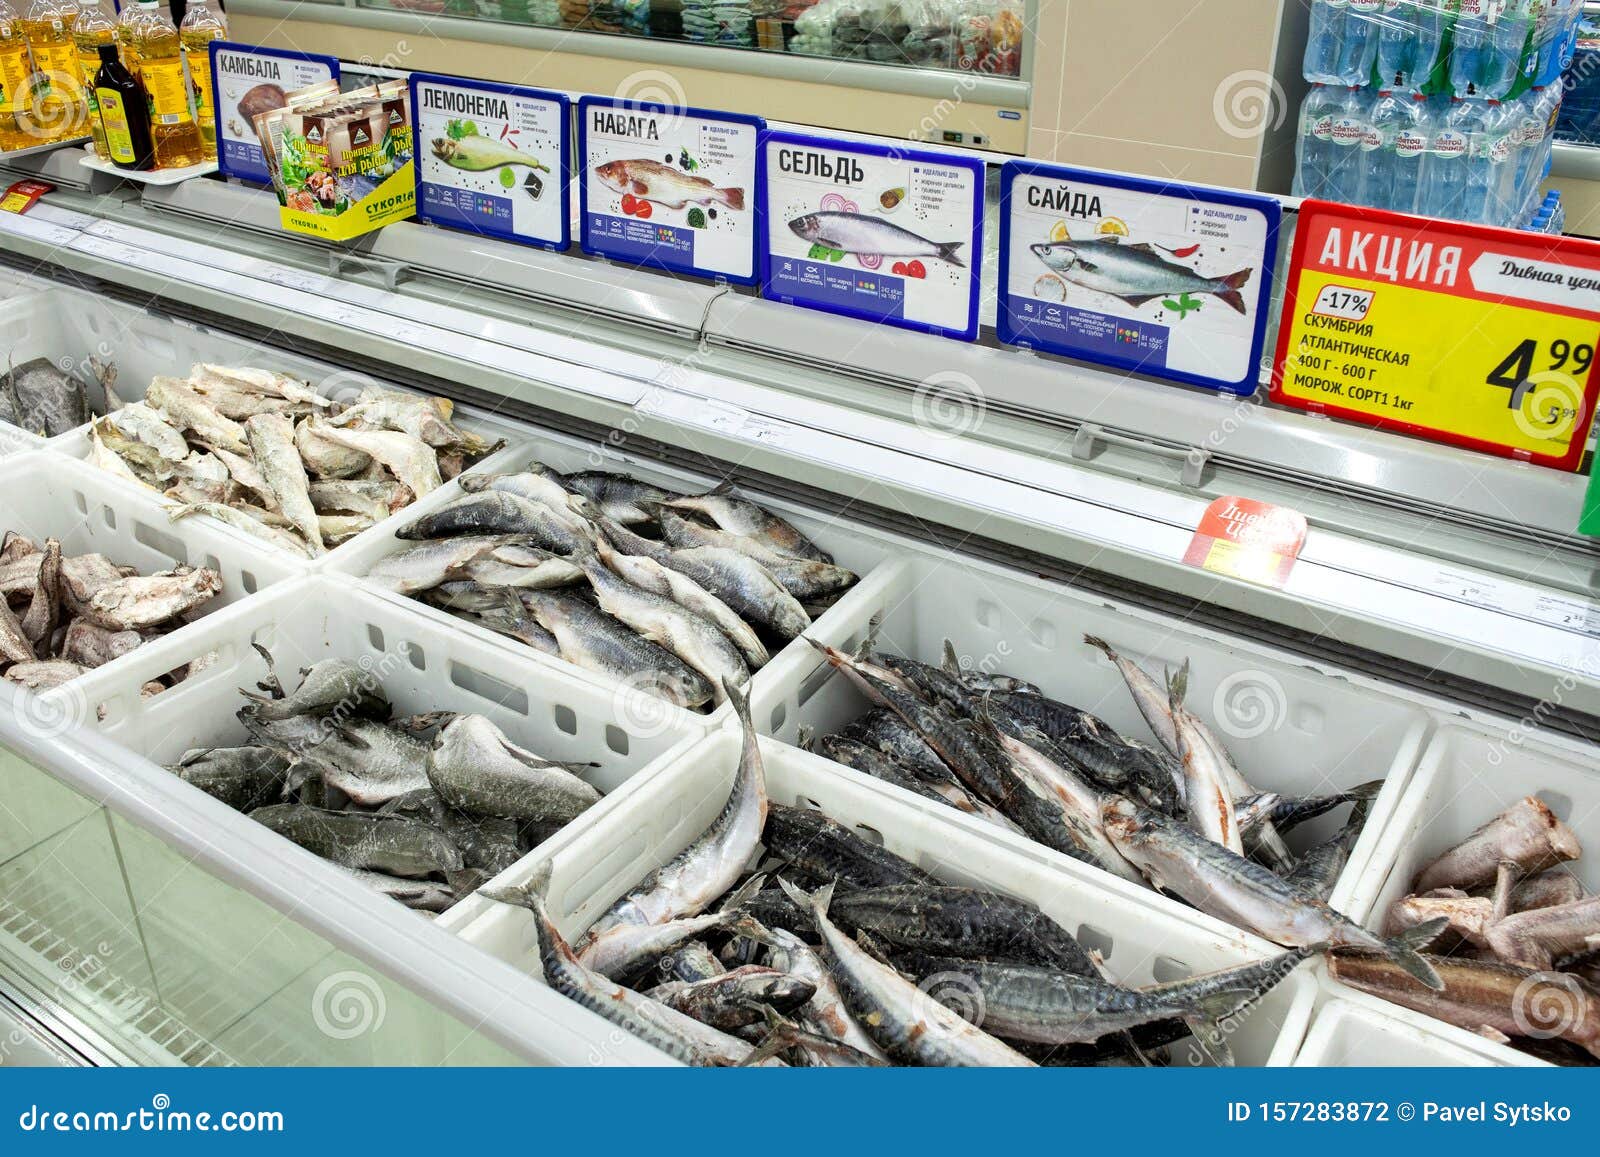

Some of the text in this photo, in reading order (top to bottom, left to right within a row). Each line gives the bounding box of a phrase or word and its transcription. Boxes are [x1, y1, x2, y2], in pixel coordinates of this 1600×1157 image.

[220, 54, 281, 80] КАМБАЛА
[424, 87, 509, 120] ЛЕМОНЕМА
[594, 111, 659, 141] НАВАГА
[779, 148, 865, 184] СЕЛЬДЬ
[365, 191, 414, 214] CYKORIA
[1028, 184, 1103, 218] САЙДА
[1203, 208, 1234, 220] ИДЕАЛЬНО
[1319, 226, 1462, 287] АКЦИЯ
[1499, 260, 1564, 285] Дивная
[1321, 291, 1368, 314] -17%
[1303, 313, 1374, 337] СКУМБРИЯ
[1300, 334, 1411, 366] АТЛАНТИЧЕСКАЯ
[1549, 339, 1595, 376] 99
[1297, 353, 1322, 371] 400
[1323, 358, 1332, 371] Г
[1341, 362, 1364, 379] 600
[1366, 367, 1377, 381] Г
[1294, 373, 1415, 411] МОРОЖ. СОРТ1 1кг
